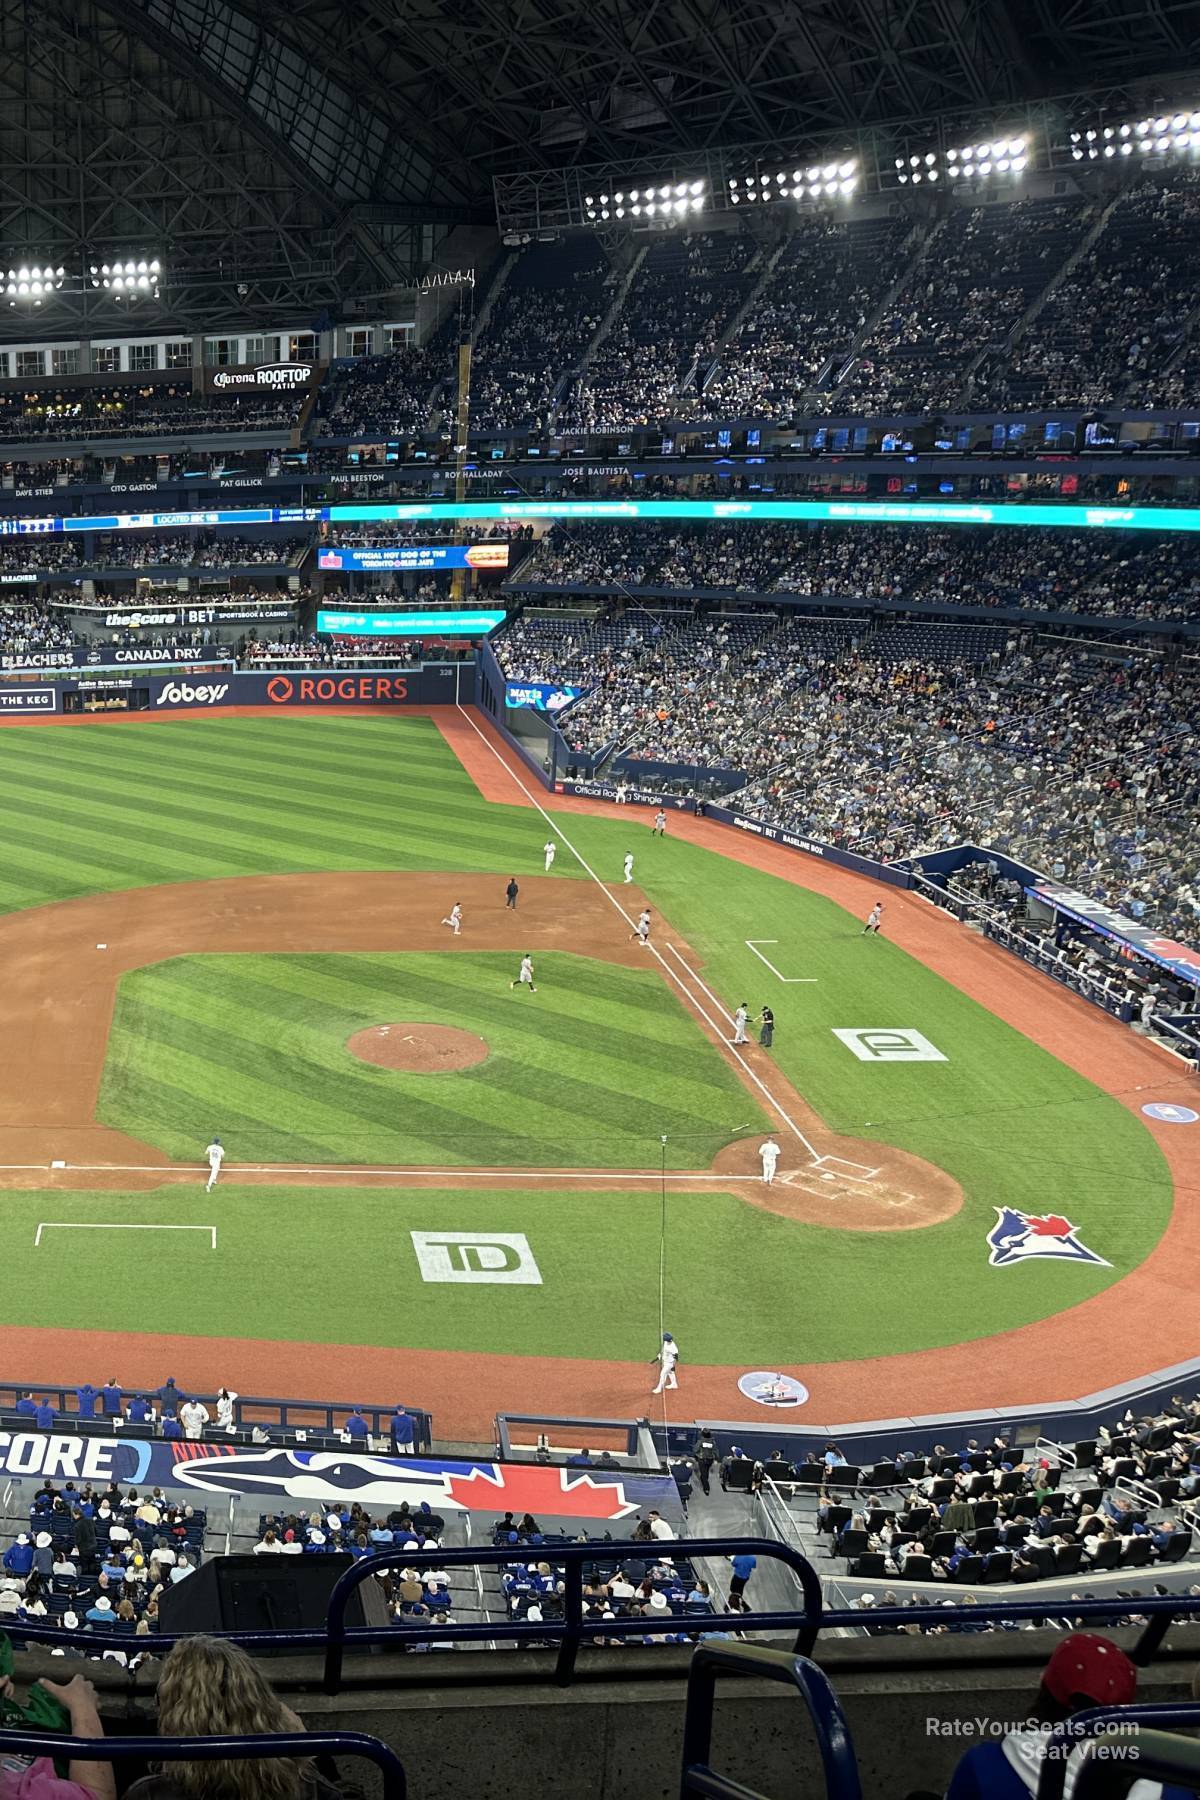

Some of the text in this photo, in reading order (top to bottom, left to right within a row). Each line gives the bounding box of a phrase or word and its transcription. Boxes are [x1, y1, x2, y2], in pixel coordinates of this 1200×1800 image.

[214, 369, 310, 388] Corona ROOFTOP
[272, 382, 295, 390] PATIO
[560, 426, 633, 435] JACKIE ROBINSON
[463, 470, 504, 478] HALLADAY
[563, 466, 629, 476] JOSÉ BAUTISTA
[331, 474, 384, 483] PAUL BEESTON
[157, 515, 190, 524] LOCATED
[1, 574, 37, 582] BLEACHERS
[106, 613, 176, 626] theScore
[189, 610, 215, 623] BET
[2, 653, 73, 668] BLEACHERS
[115, 650, 171, 661] CANADA
[157, 682, 228, 705] Sobeys
[300, 678, 407, 699] ROGERS
[510, 689, 530, 697] MAY
[1, 696, 48, 704] THE KEG
[575, 786, 601, 795] Official
[634, 793, 662, 804] Shingle
[734, 817, 823, 855] theScore BET BASELINE BOX
[425, 1242, 521, 1272] TD
